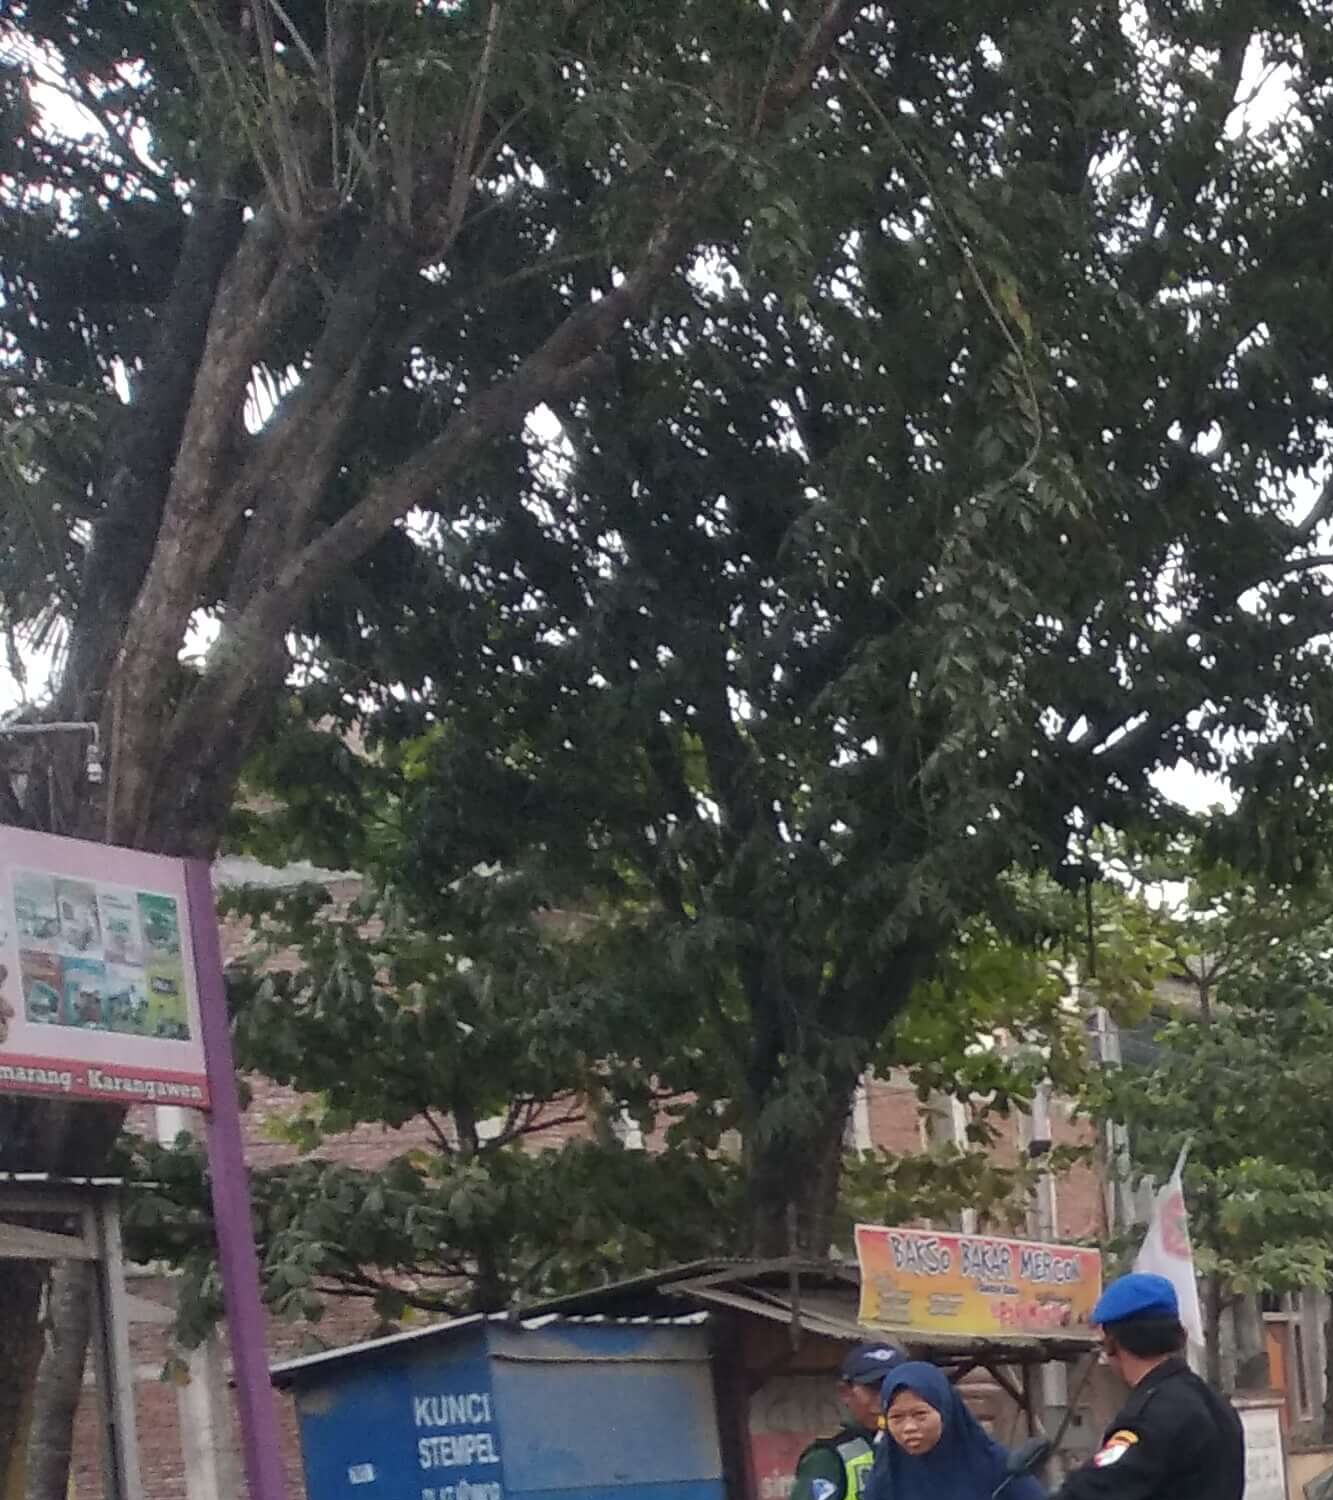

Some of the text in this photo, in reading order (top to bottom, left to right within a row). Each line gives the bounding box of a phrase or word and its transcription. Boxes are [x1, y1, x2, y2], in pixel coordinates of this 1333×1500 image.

[88, 1069, 202, 1099] Karangawen
[959, 1240, 1013, 1281] BAKAR
[1019, 1248, 1082, 1284] MERCON
[414, 1393, 491, 1426] KUNCI
[418, 1433, 500, 1469] STEMPEL
